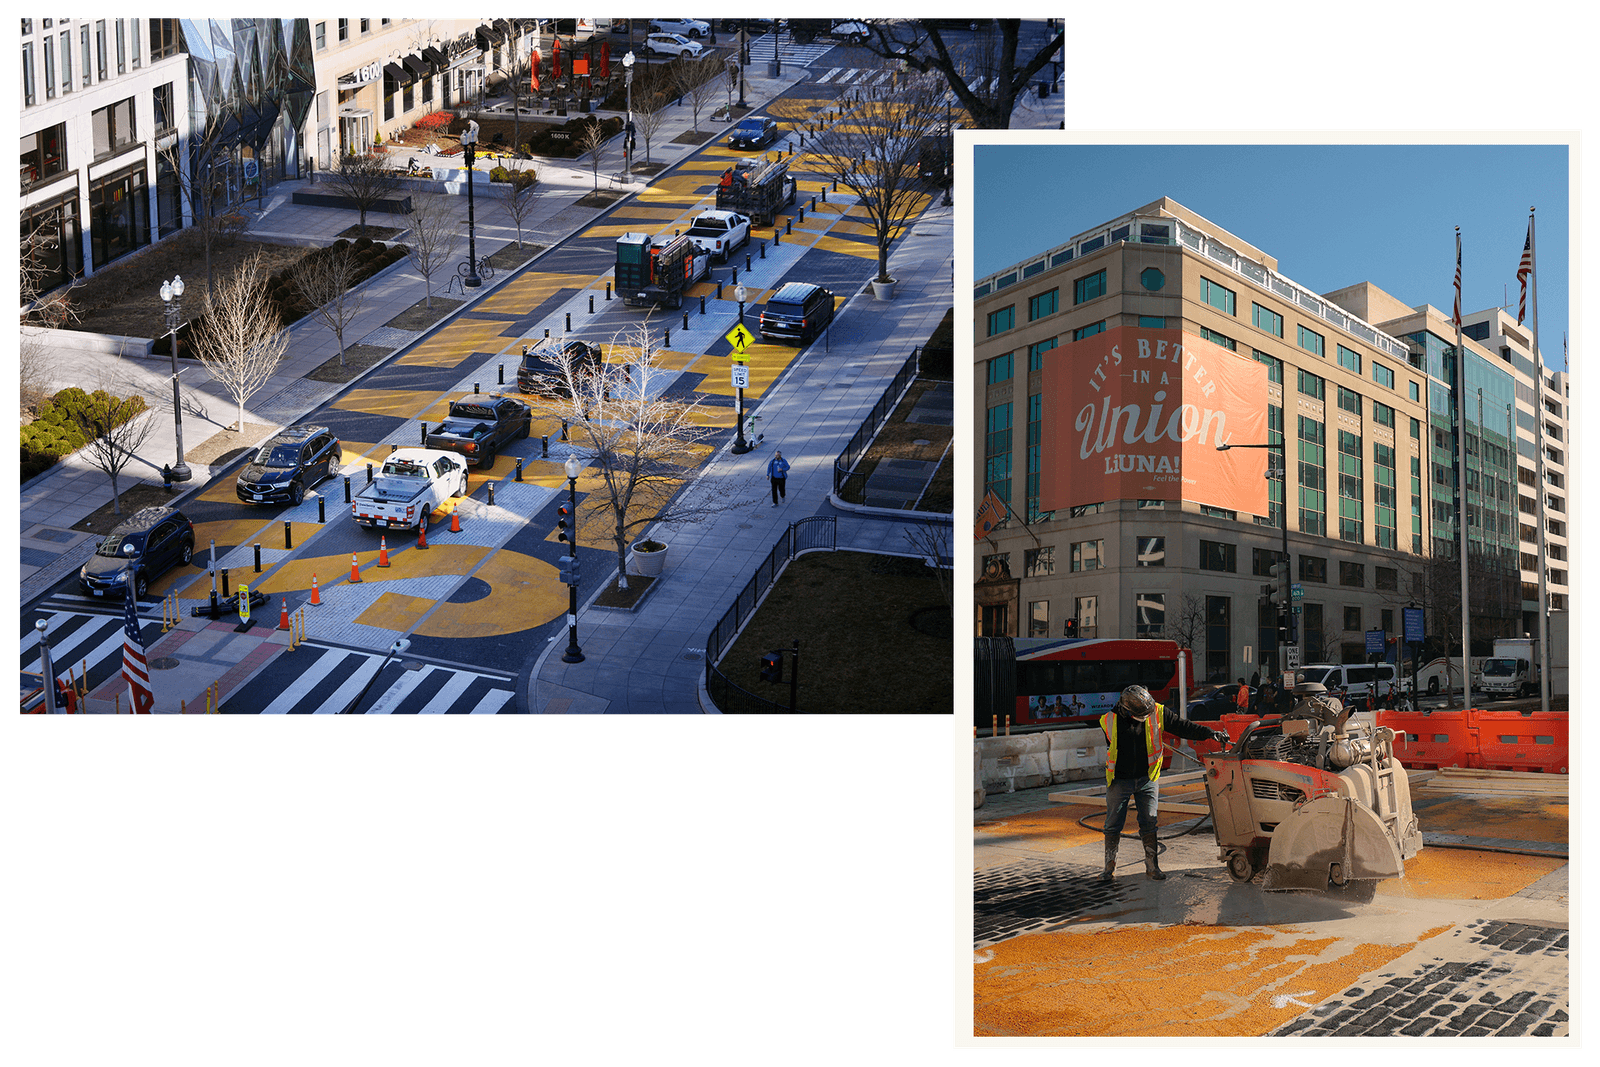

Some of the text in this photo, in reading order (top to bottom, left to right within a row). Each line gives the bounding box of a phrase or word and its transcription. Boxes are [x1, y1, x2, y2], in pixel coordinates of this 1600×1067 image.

[353, 62, 380, 84] 1600
[1132, 369, 1169, 385] IN A
[1137, 338, 1217, 398] BETTER
[735, 376, 745, 385] 15
[1075, 390, 1232, 460] Union
[1168, 474, 1179, 482] the
[1180, 476, 1197, 485] Power
